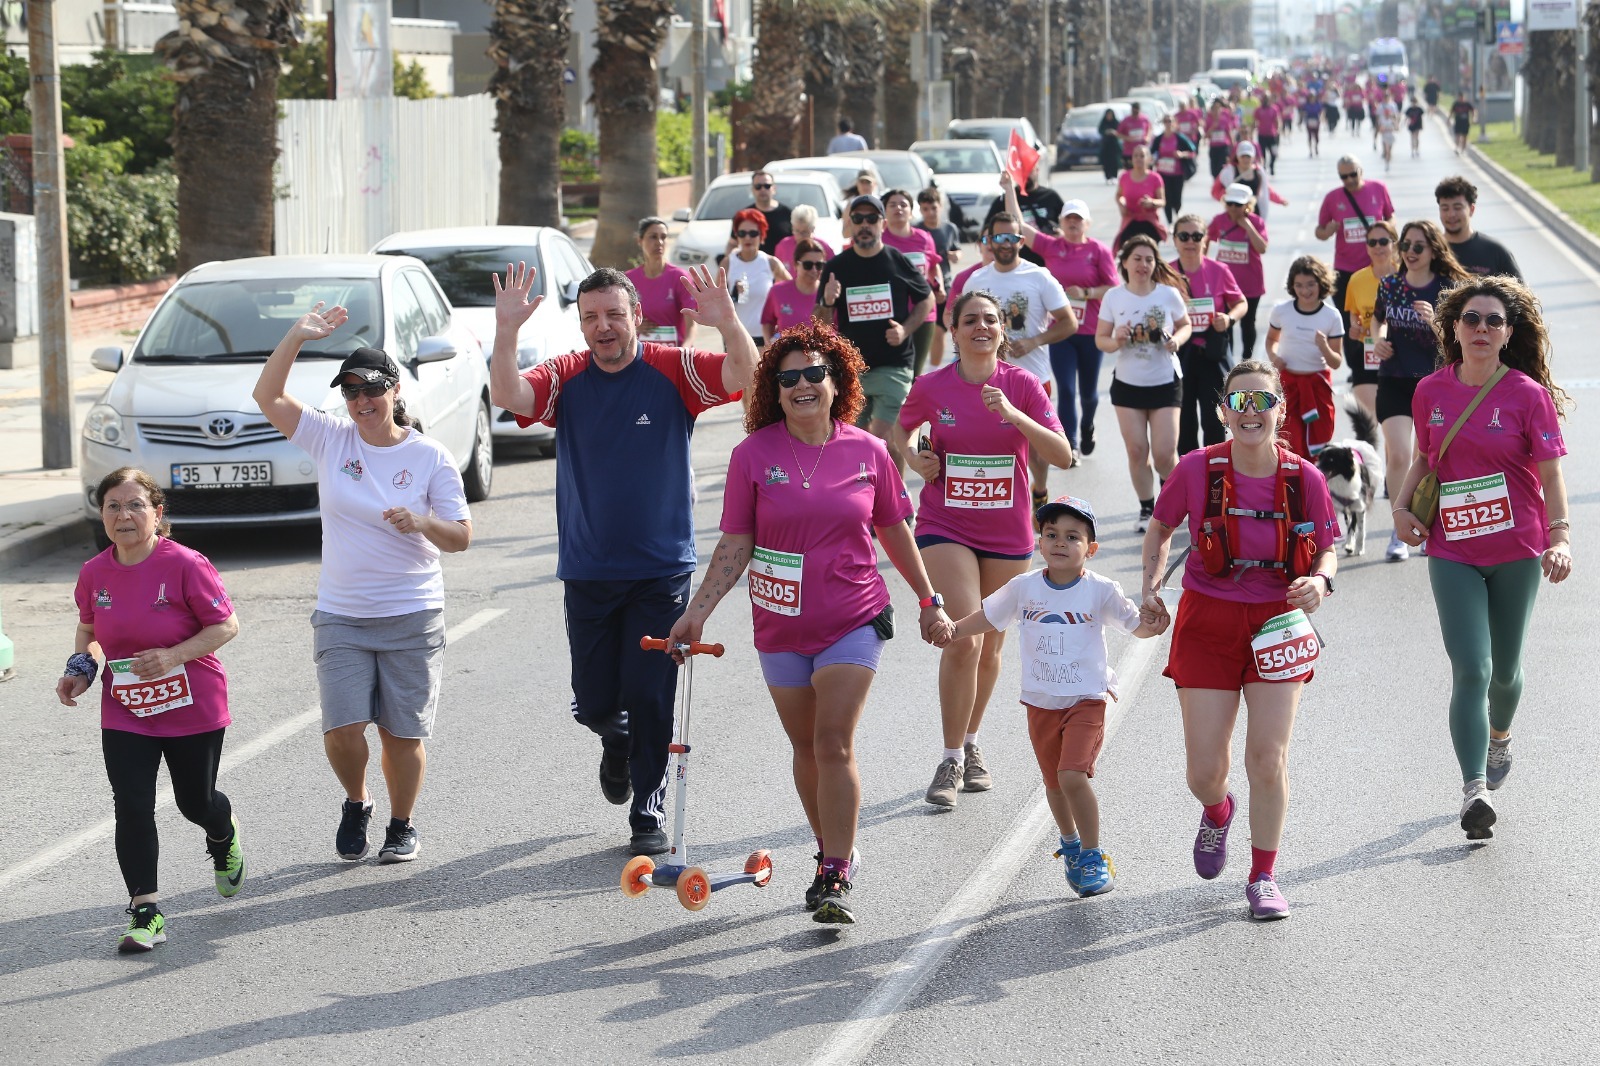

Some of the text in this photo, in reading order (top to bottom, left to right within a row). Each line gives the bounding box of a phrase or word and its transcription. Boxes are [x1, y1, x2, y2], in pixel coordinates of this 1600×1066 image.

[850, 301, 890, 315] 35209
[1191, 313, 1210, 325] 112
[182, 465, 268, 483] 35 Y 7935
[950, 481, 1008, 498] 35214
[1445, 503, 1505, 530] 35125
[751, 574, 796, 604] 35305
[1258, 638, 1319, 670] 35049
[116, 680, 183, 706] 35233
